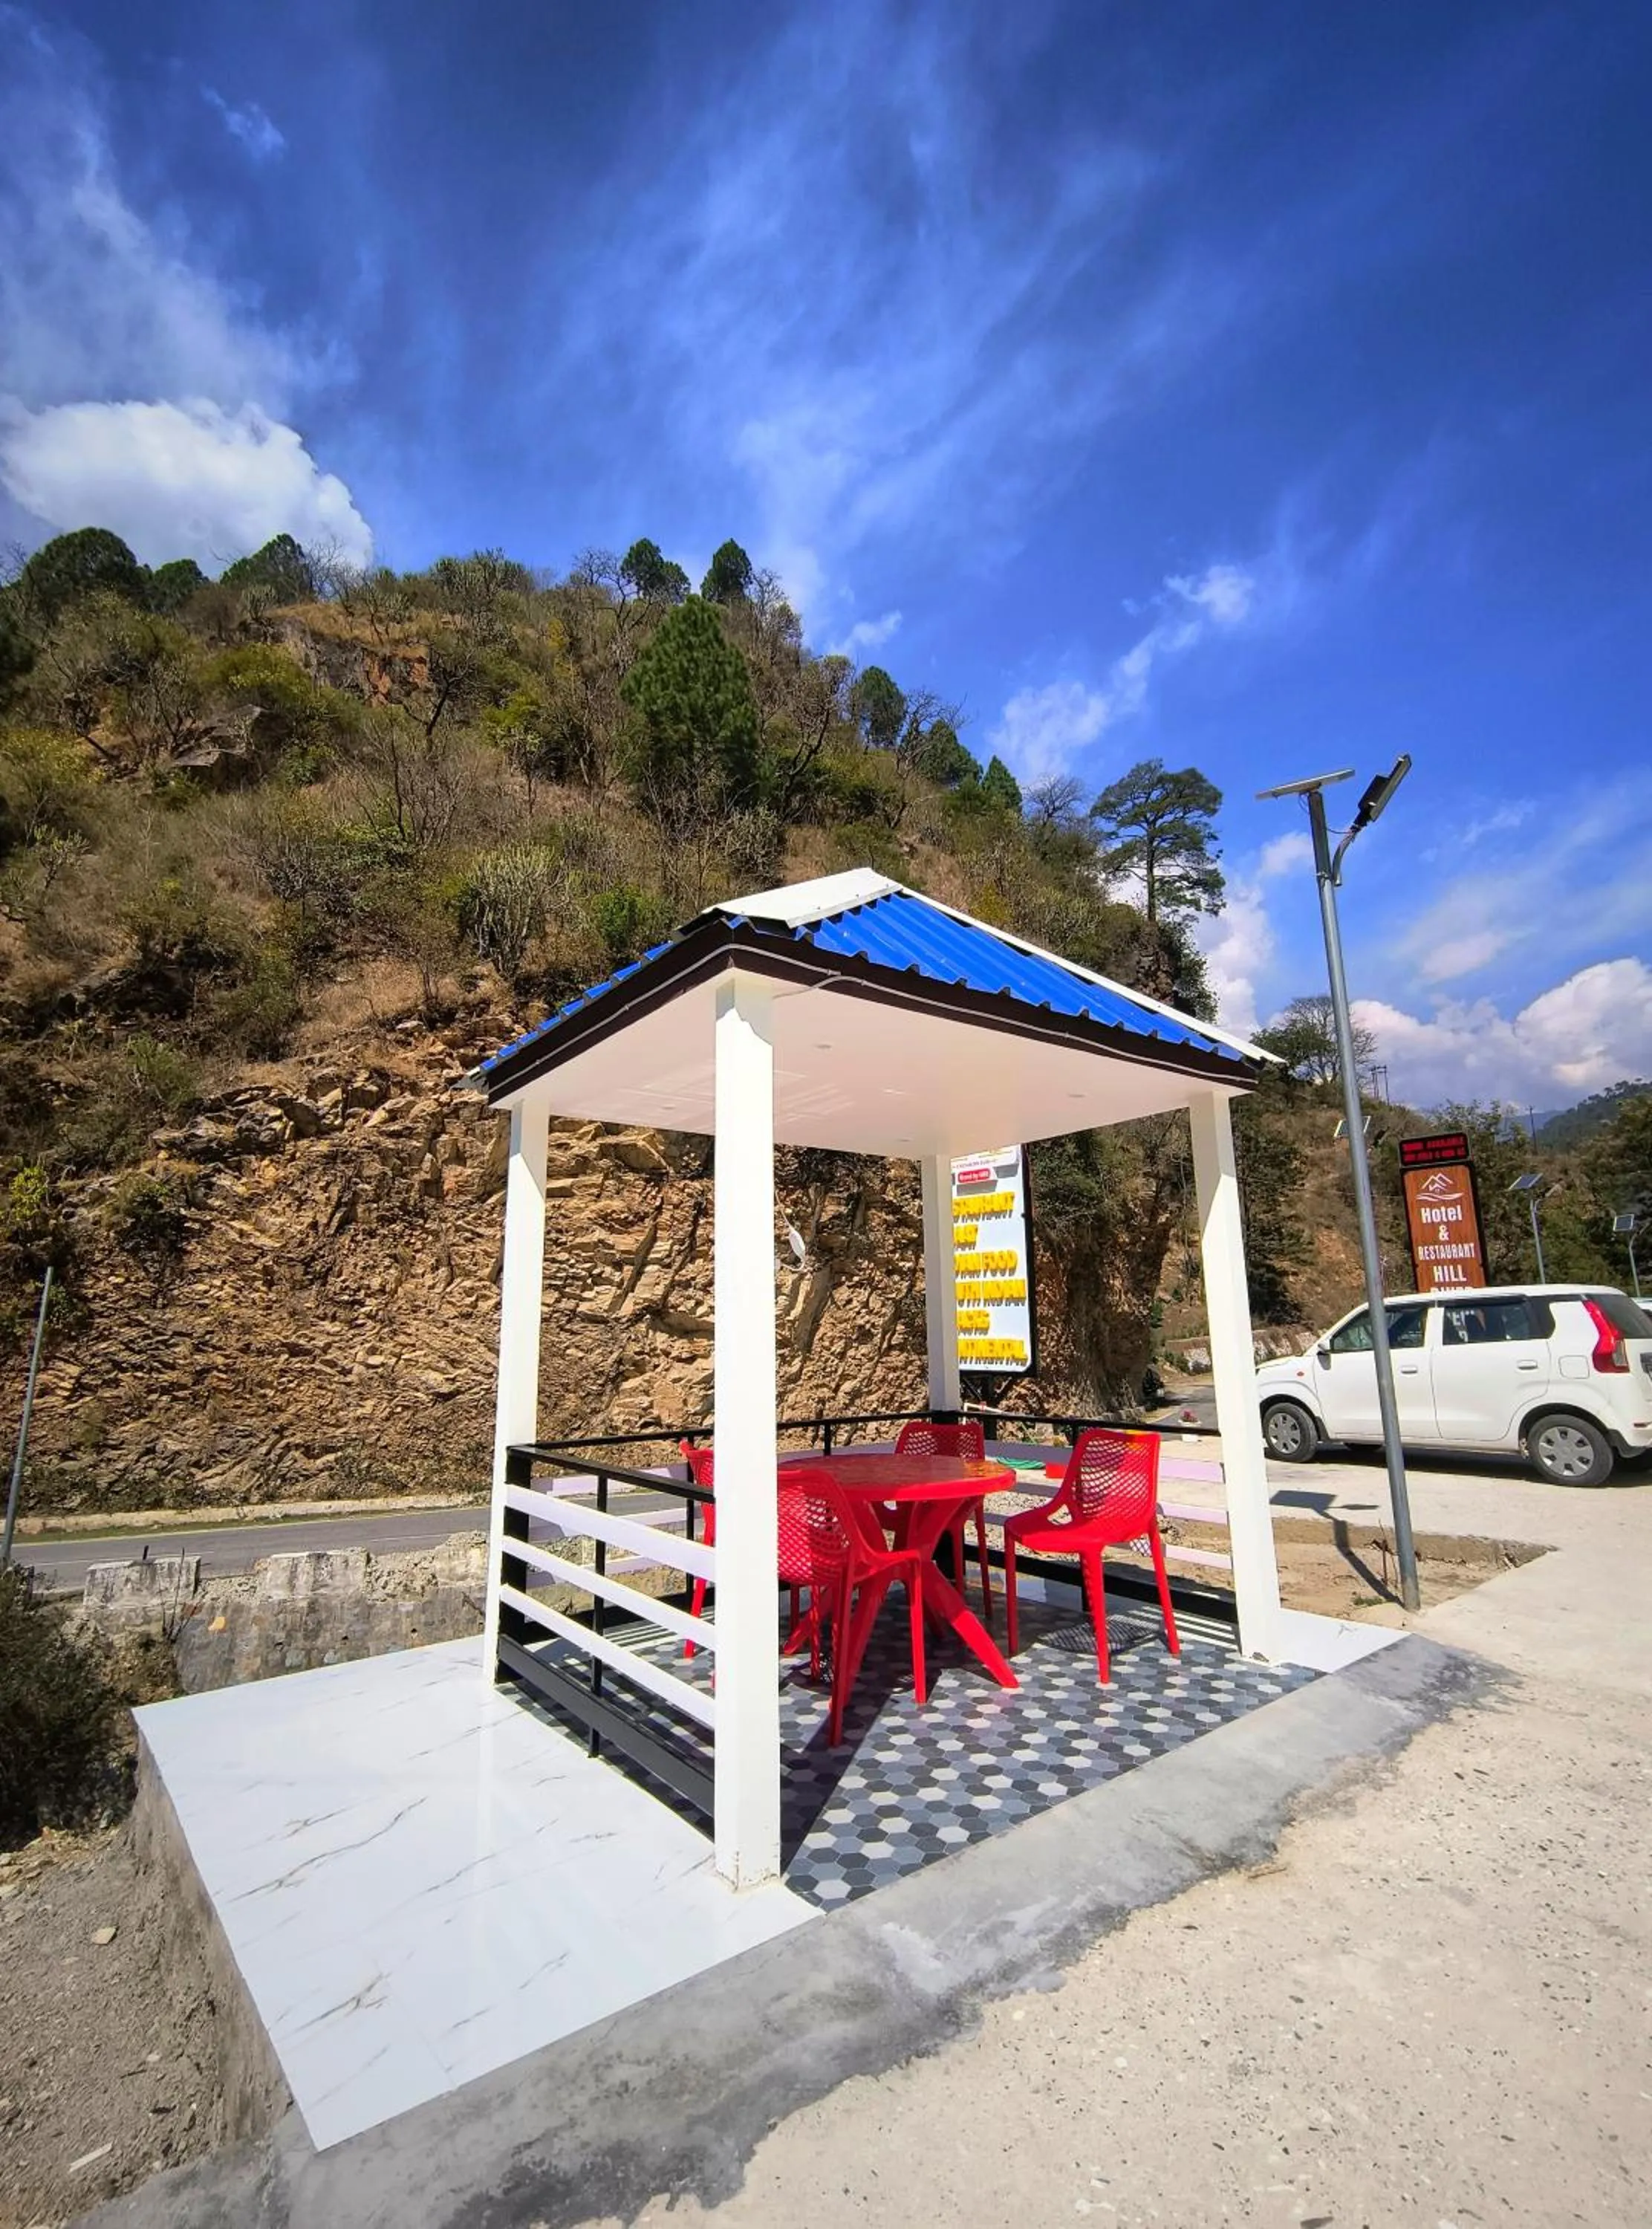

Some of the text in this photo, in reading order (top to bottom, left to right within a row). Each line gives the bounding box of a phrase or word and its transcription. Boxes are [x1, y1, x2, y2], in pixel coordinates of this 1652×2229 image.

[954, 1192, 1015, 1213] STAURANT
[1421, 1204, 1463, 1224] Hotel
[1439, 1224, 1449, 1241] &
[982, 1250, 1018, 1271] FOOD
[1418, 1242, 1474, 1261] RESTAURANT
[1433, 1265, 1466, 1282] HILL
[956, 1281, 981, 1300] UTH
[957, 1339, 1027, 1361] NTINENTAL
